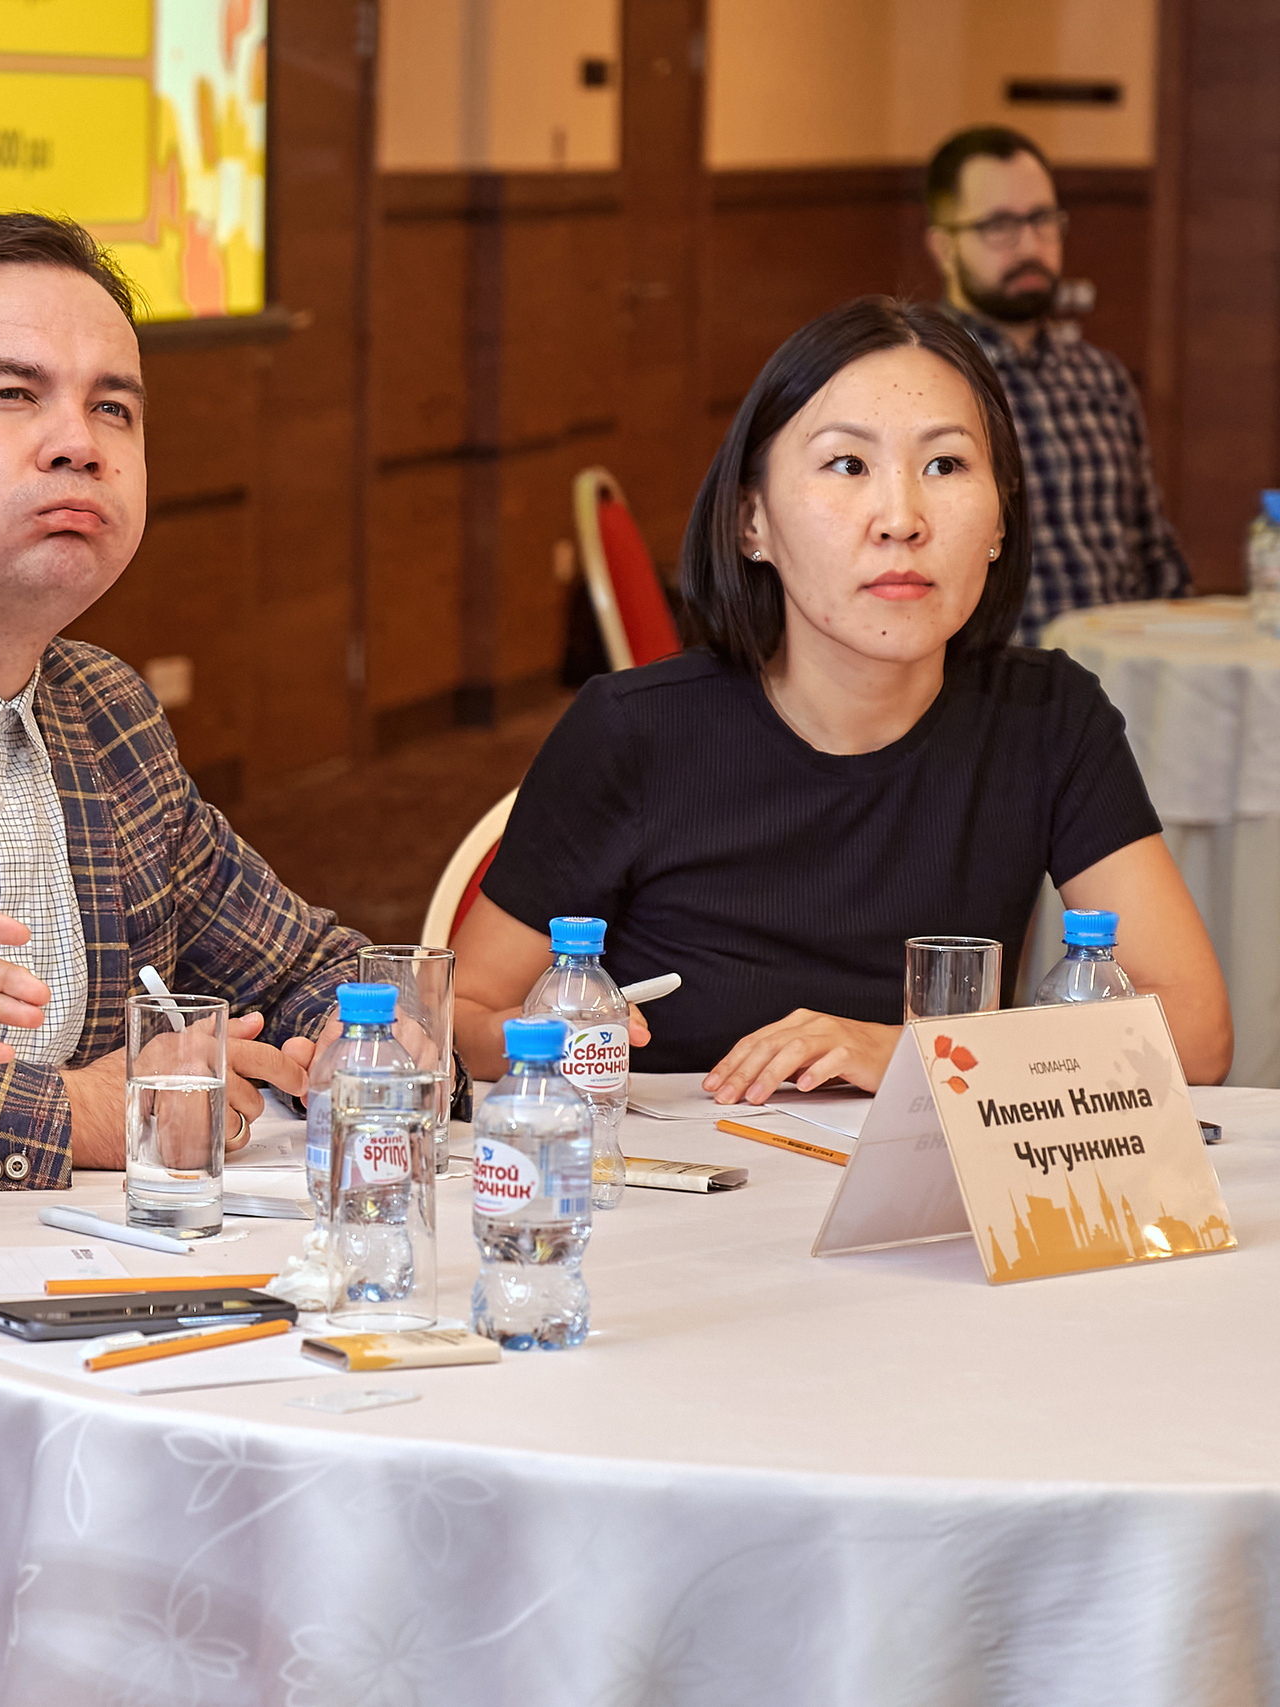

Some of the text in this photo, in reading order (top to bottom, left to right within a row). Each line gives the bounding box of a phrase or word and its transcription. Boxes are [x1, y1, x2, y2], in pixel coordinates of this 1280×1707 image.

[573, 1043, 627, 1061] святой
[562, 1060, 629, 1076] источни
[1028, 1058, 1082, 1076] КОМАНДА
[977, 1087, 1154, 1128] Имени Клима
[370, 1134, 403, 1145] saint
[363, 1144, 409, 1174] spring
[1013, 1134, 1146, 1176] Чугункина
[473, 1157, 519, 1182] вятой
